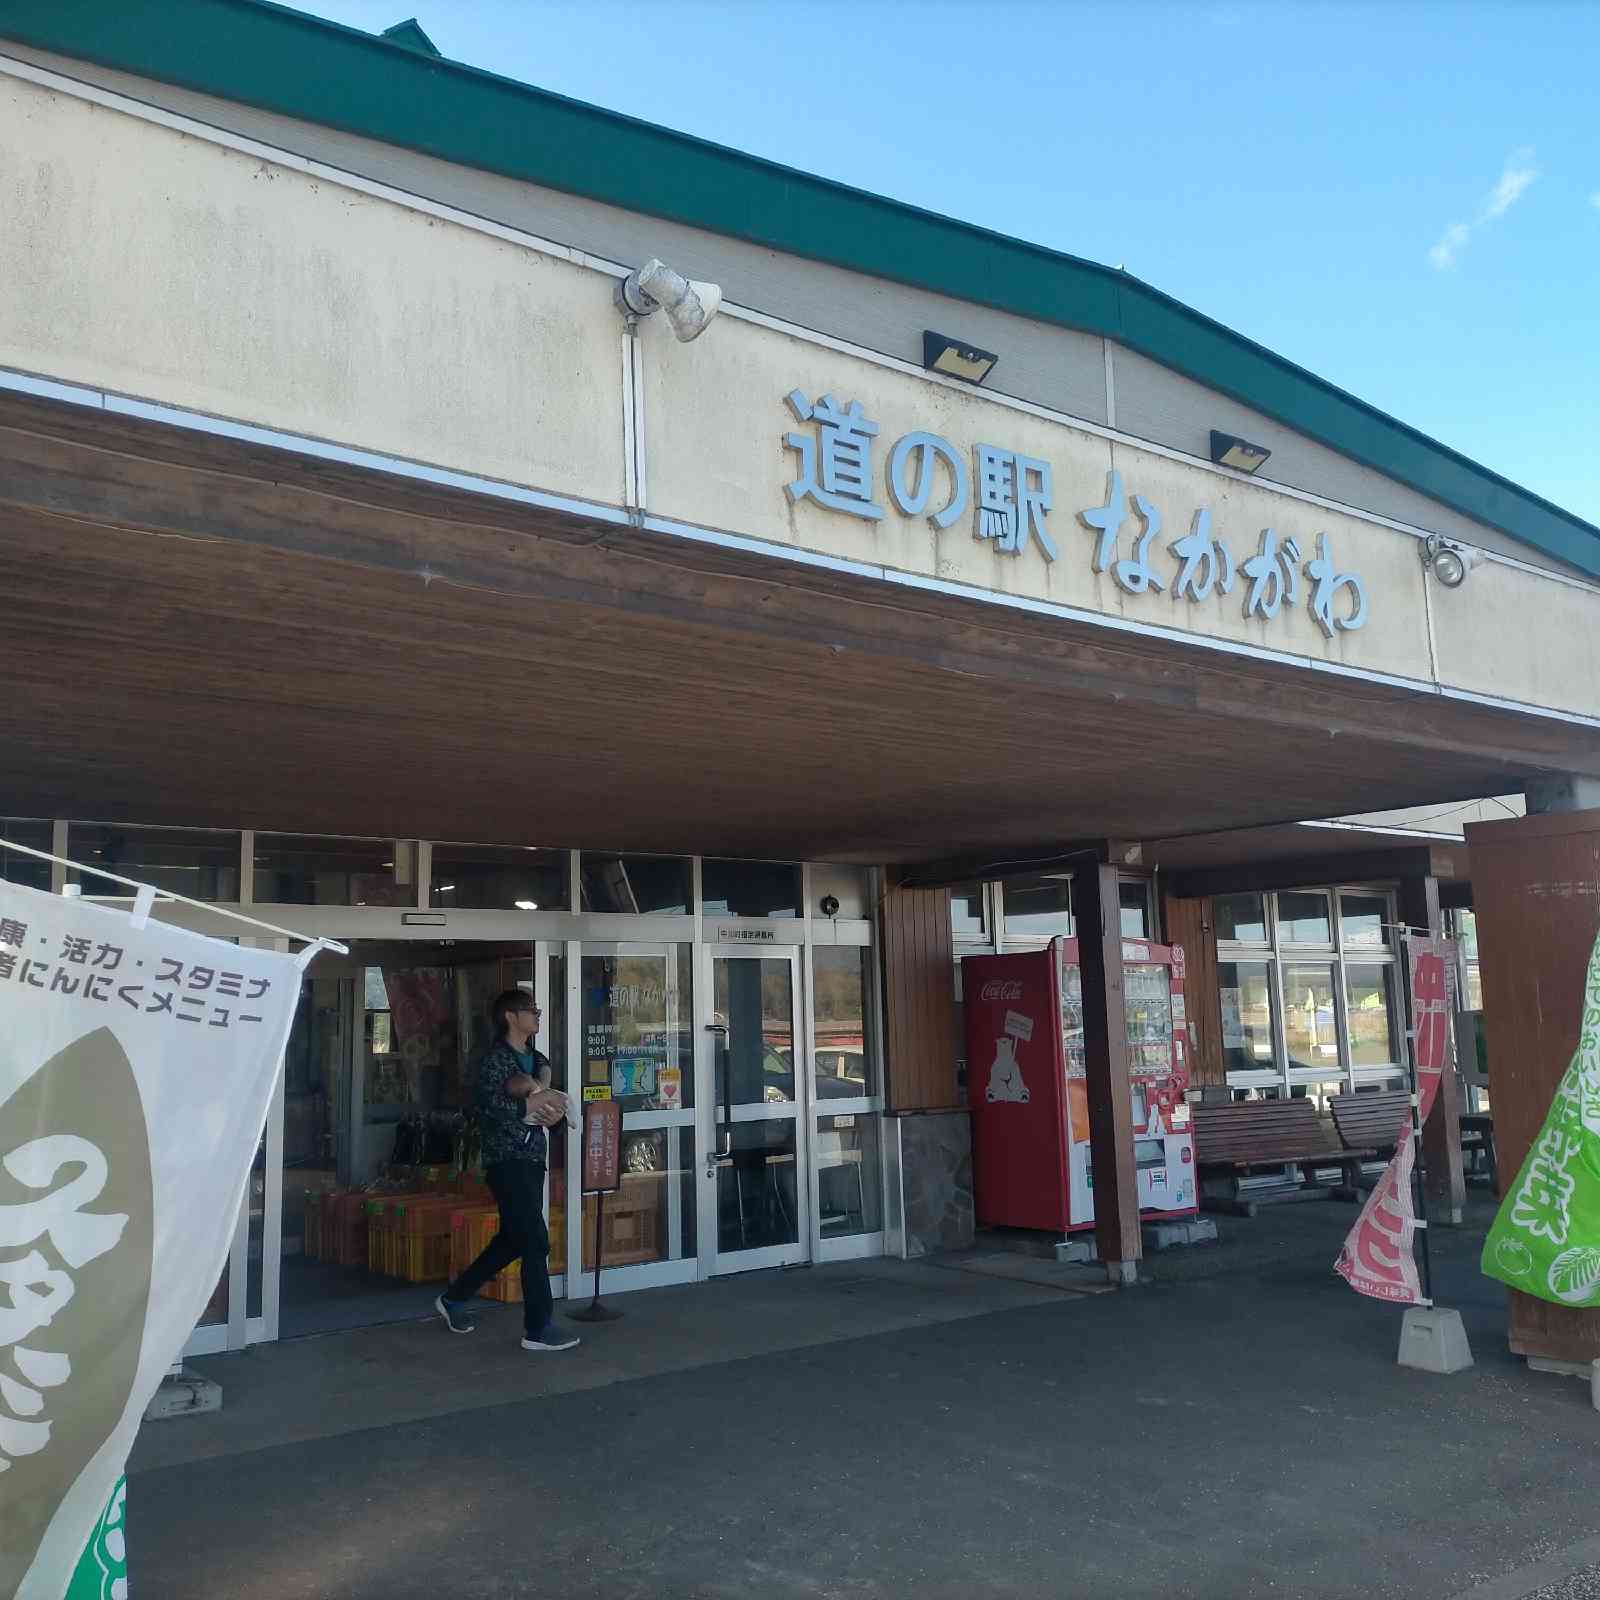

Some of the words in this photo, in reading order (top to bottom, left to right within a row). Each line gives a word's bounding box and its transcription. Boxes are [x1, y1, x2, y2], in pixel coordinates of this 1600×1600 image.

[782, 388, 1058, 564] 道の駅
[1076, 470, 1368, 640] なかがわ
